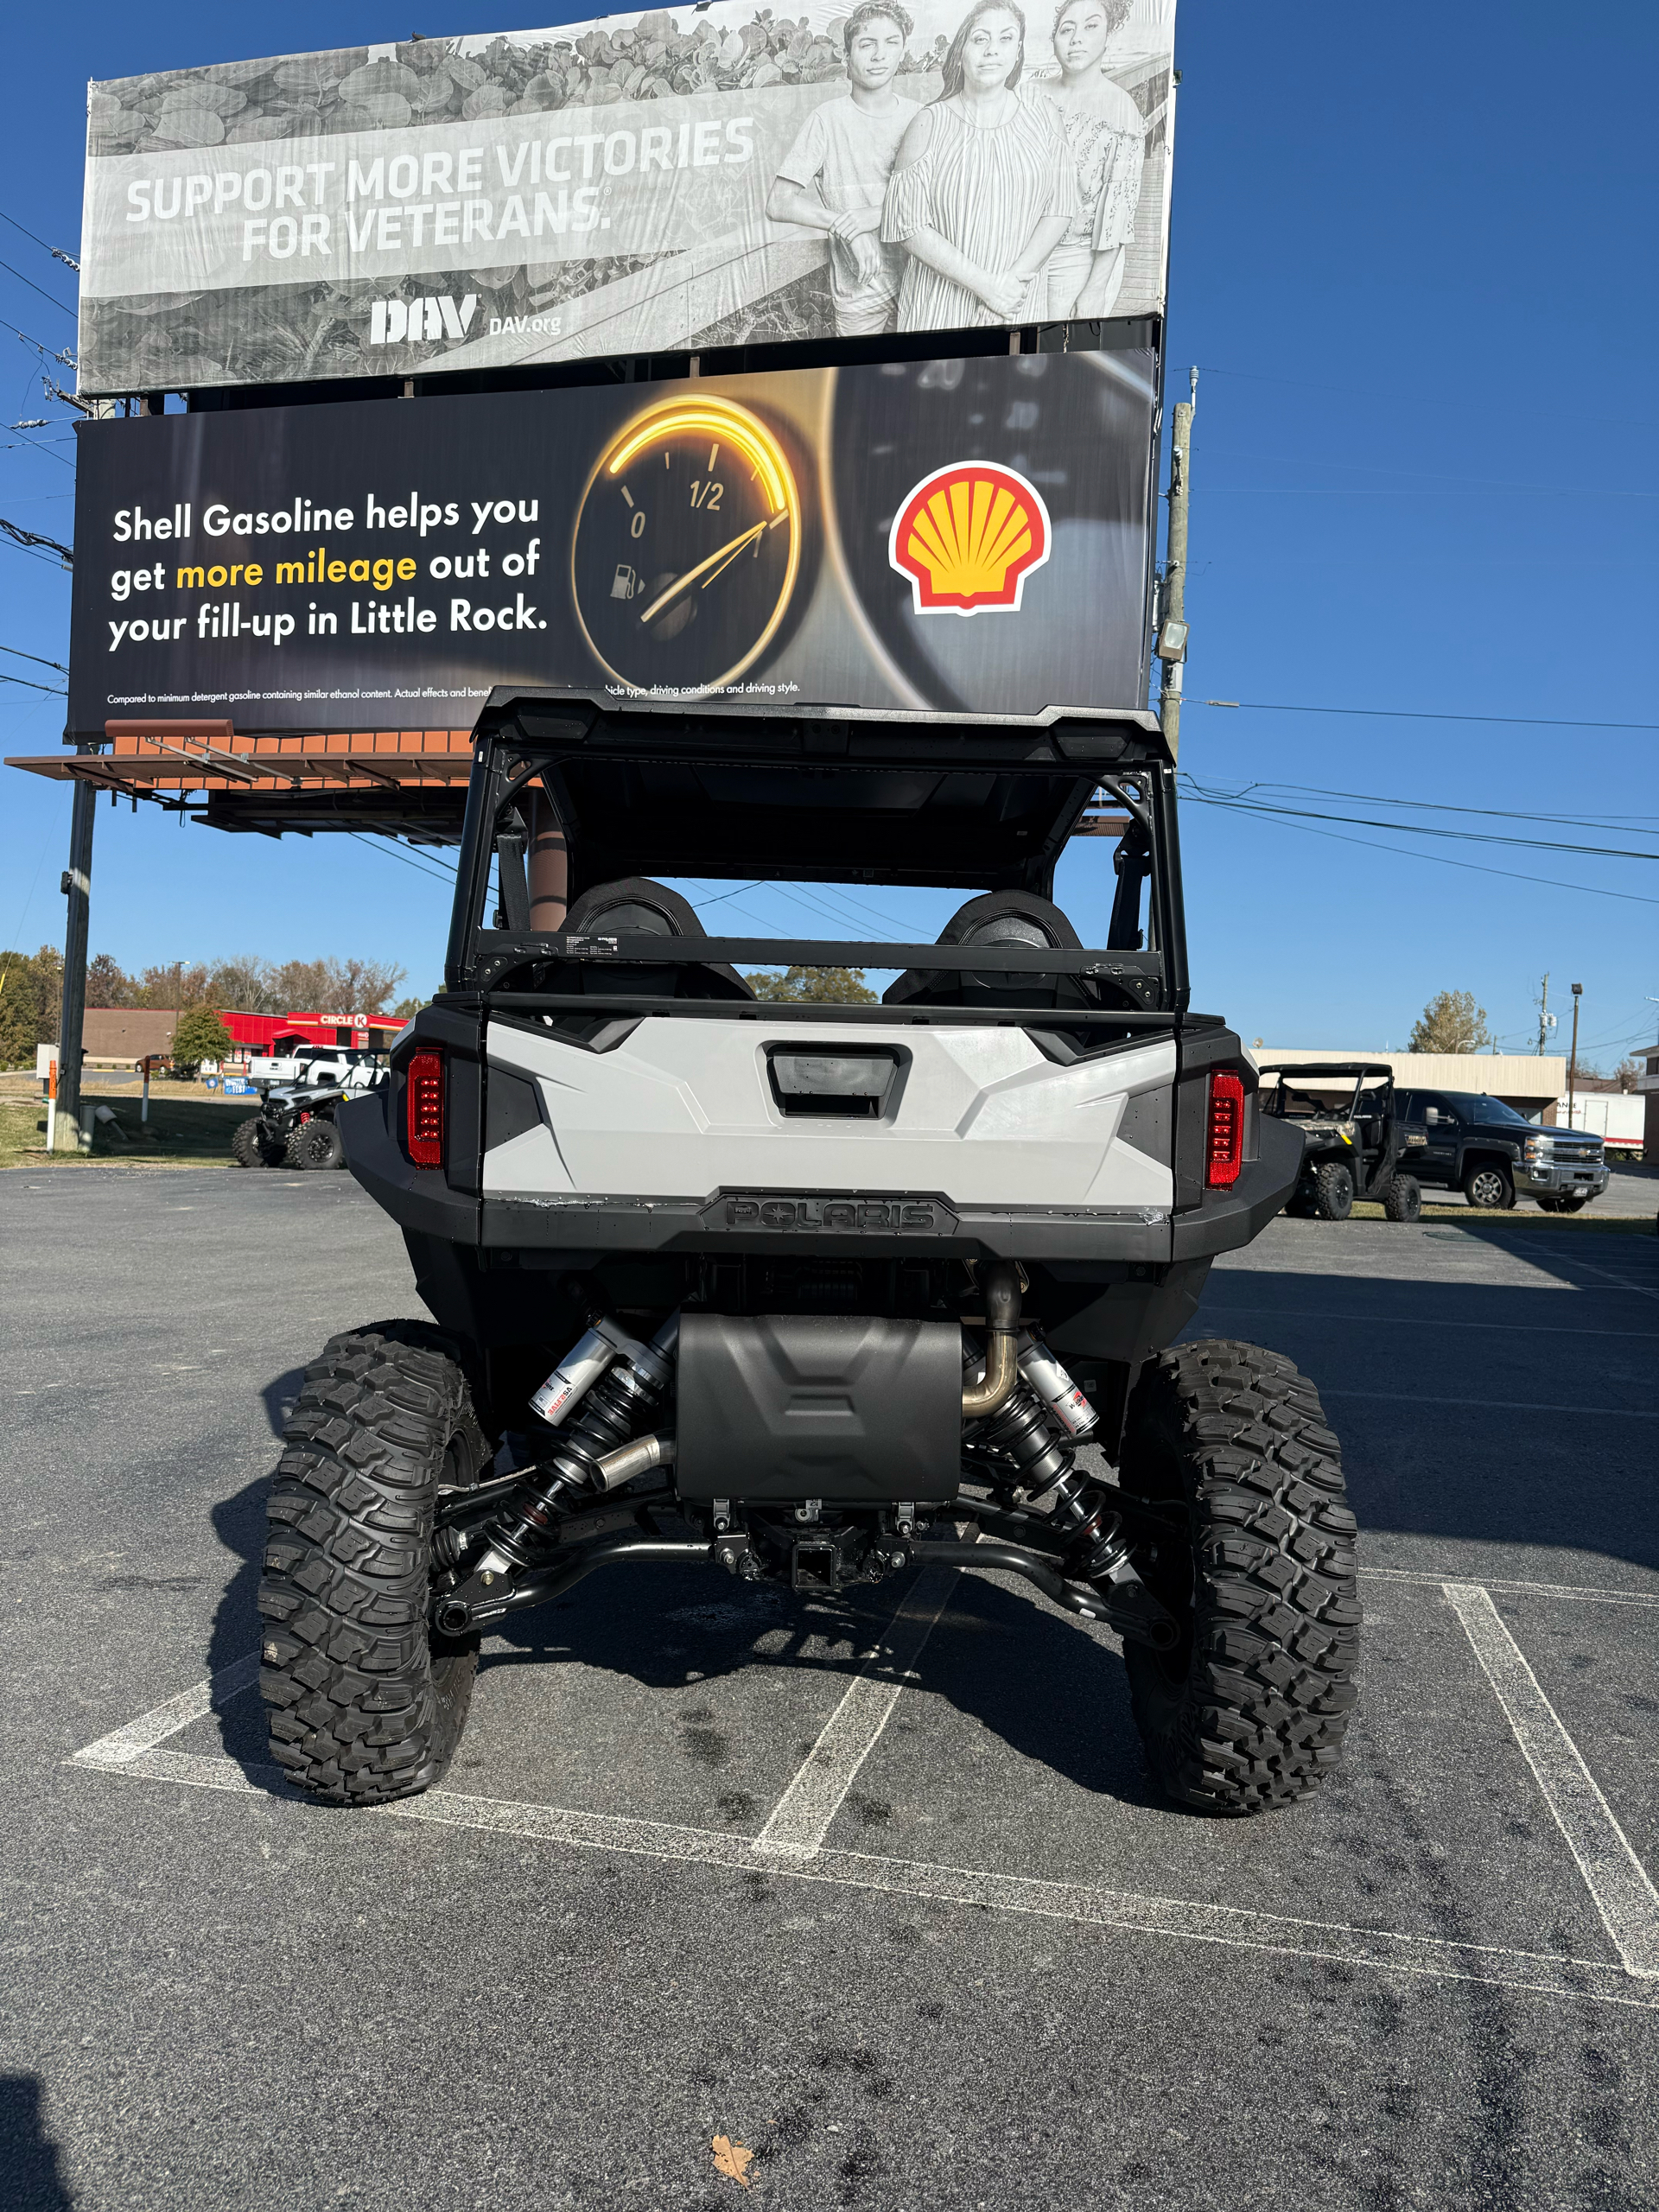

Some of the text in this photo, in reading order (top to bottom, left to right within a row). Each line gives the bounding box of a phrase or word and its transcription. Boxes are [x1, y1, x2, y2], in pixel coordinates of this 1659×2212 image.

[125, 117, 754, 222] SUPPORT MORE VICTORIES
[242, 214, 333, 261] FOR
[370, 294, 477, 345] DAV
[489, 315, 563, 336] DAV.org
[690, 480, 724, 511] 1/2
[113, 491, 538, 542] Shell Gasoline helps you
[631, 512, 645, 538] 0
[111, 537, 541, 601] get more mileage out of
[108, 592, 548, 652] your fill-up in Little Rock.
[107, 693, 147, 705] Compared
[149, 694, 156, 702] to
[157, 693, 190, 702] minimum
[191, 691, 227, 703] detergent
[229, 690, 261, 702] gasoline
[262, 690, 302, 701] containing
[303, 689, 328, 699] similar
[330, 688, 359, 698] ethanol
[361, 689, 392, 698] content.
[395, 687, 420, 698] Actual
[422, 686, 448, 697] effects
[450, 686, 466, 697] and
[626, 686, 648, 698] type,
[650, 683, 678, 697] driving
[681, 683, 724, 695] conditions
[727, 683, 744, 694] and
[746, 683, 775, 695] driving
[778, 681, 800, 695] style.
[321, 1015, 367, 1027] CIRCLE K
[726, 1201, 934, 1230] POLARIS
